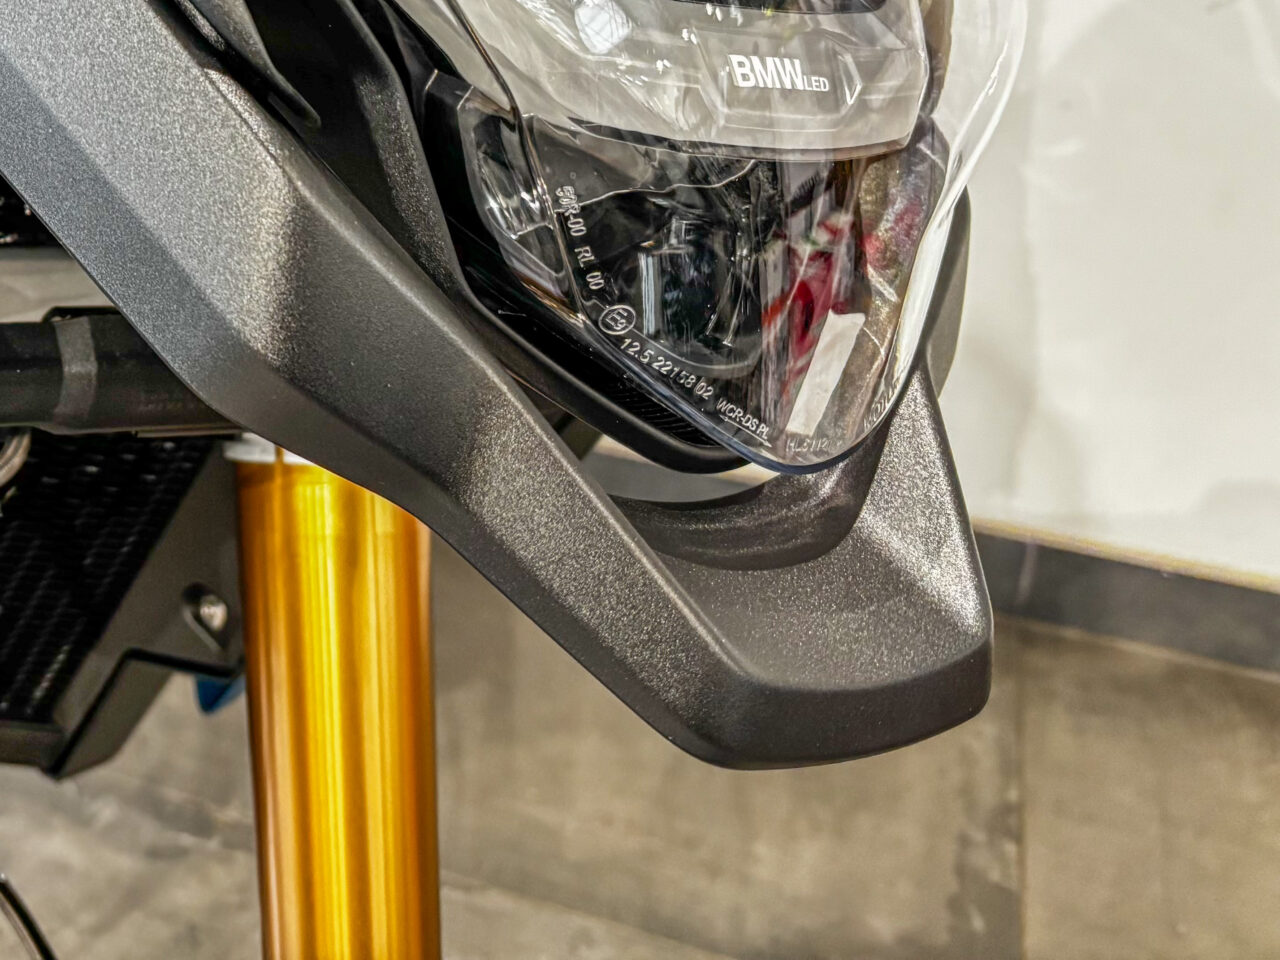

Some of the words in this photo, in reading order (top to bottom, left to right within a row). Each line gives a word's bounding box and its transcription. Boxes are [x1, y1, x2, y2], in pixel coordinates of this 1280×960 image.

[728, 54, 804, 90] BMW
[804, 75, 829, 92] LED
[585, 271, 605, 290] 00
